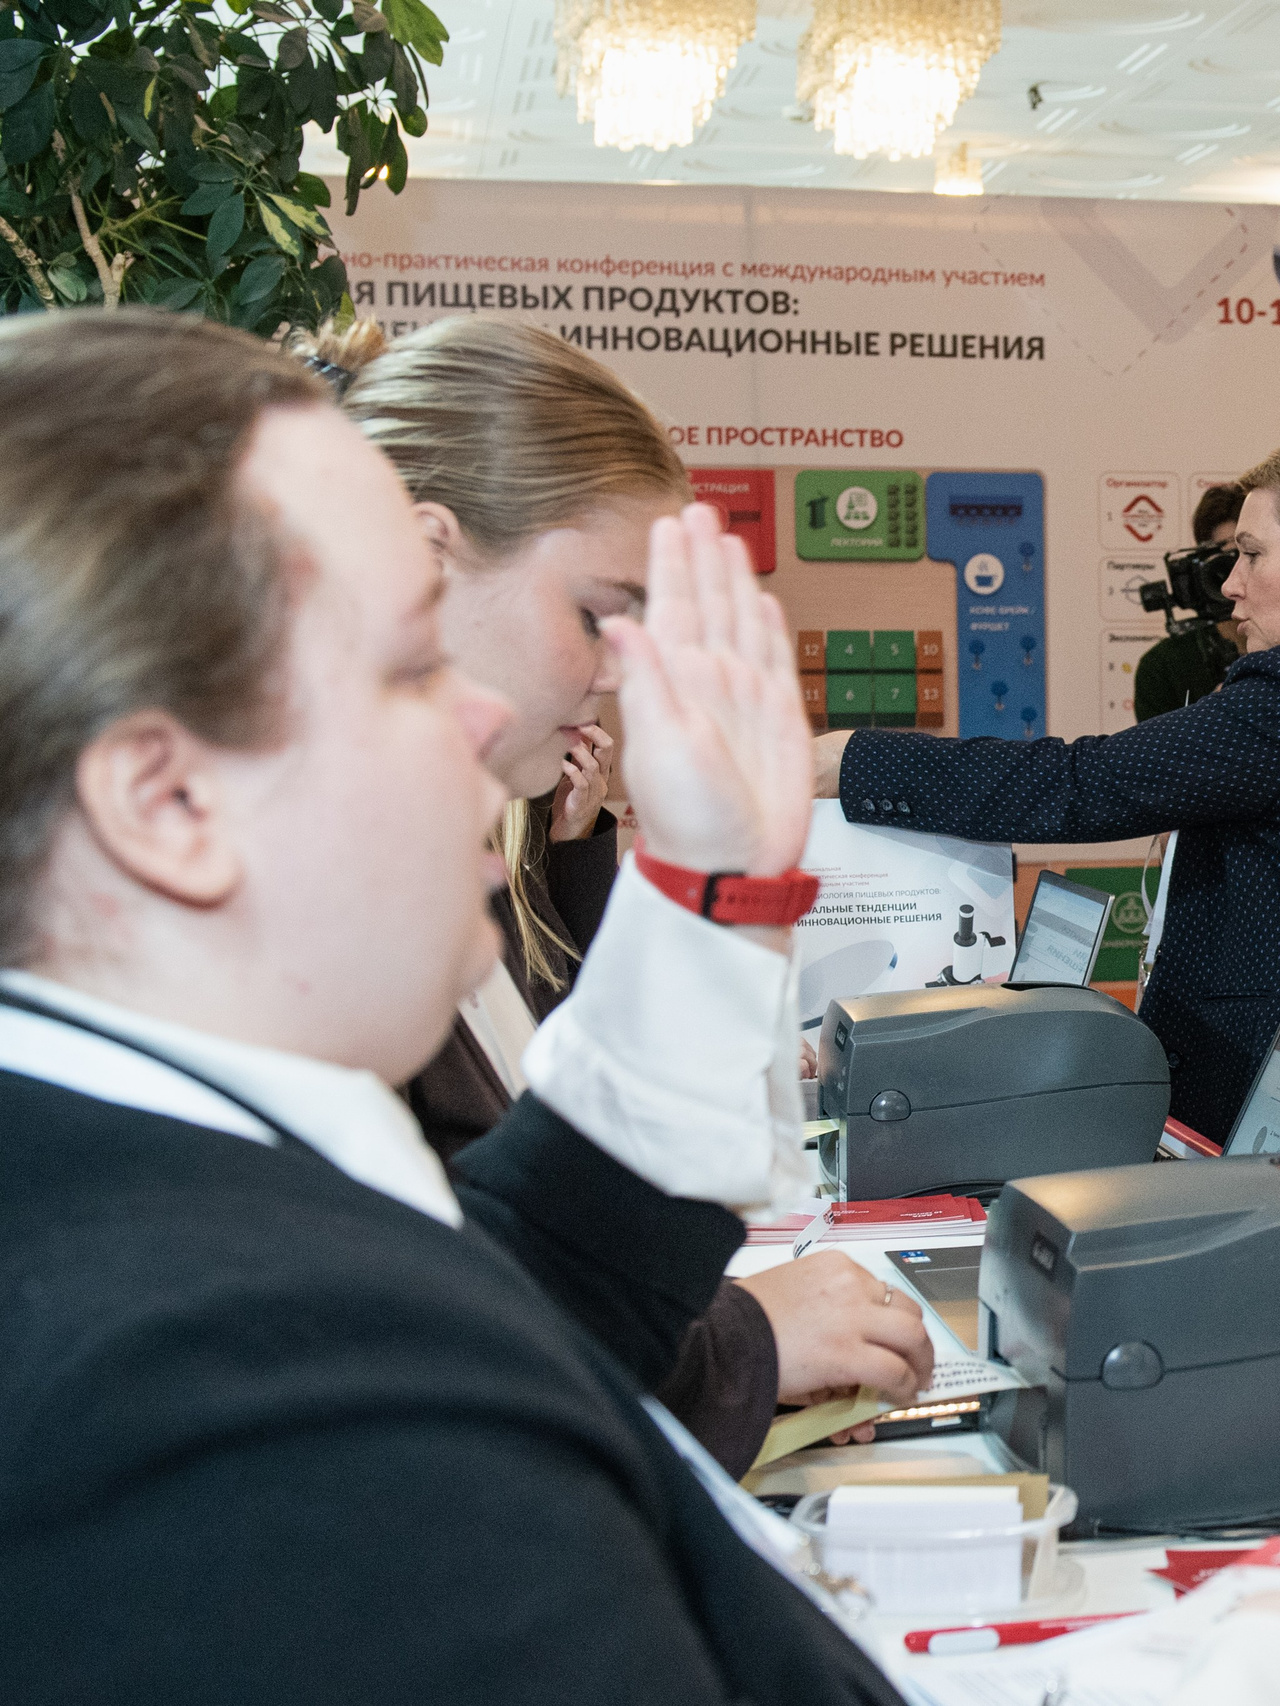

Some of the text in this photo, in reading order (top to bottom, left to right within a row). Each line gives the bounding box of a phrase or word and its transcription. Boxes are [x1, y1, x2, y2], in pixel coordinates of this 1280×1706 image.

[343, 252, 1046, 287] но-практическая конференция с международным участием
[386, 281, 573, 313] ПИЩЕВЫХ
[582, 285, 800, 318] ПРОДУКТОВ:
[560, 324, 1045, 361] ИННОВАЦИОННЫЕ РЕШЕНИЯ
[706, 426, 904, 448] ПРОСТРАНСТВО
[817, 892, 854, 900] ИОЛОГИЯ
[855, 890, 894, 899] ПИЩЕВЫХ
[855, 902, 917, 914] ТЕНДЕНЦИИ
[797, 913, 943, 927] ИННОВАЦИОННЫЕ РЕШЕНИЯ
